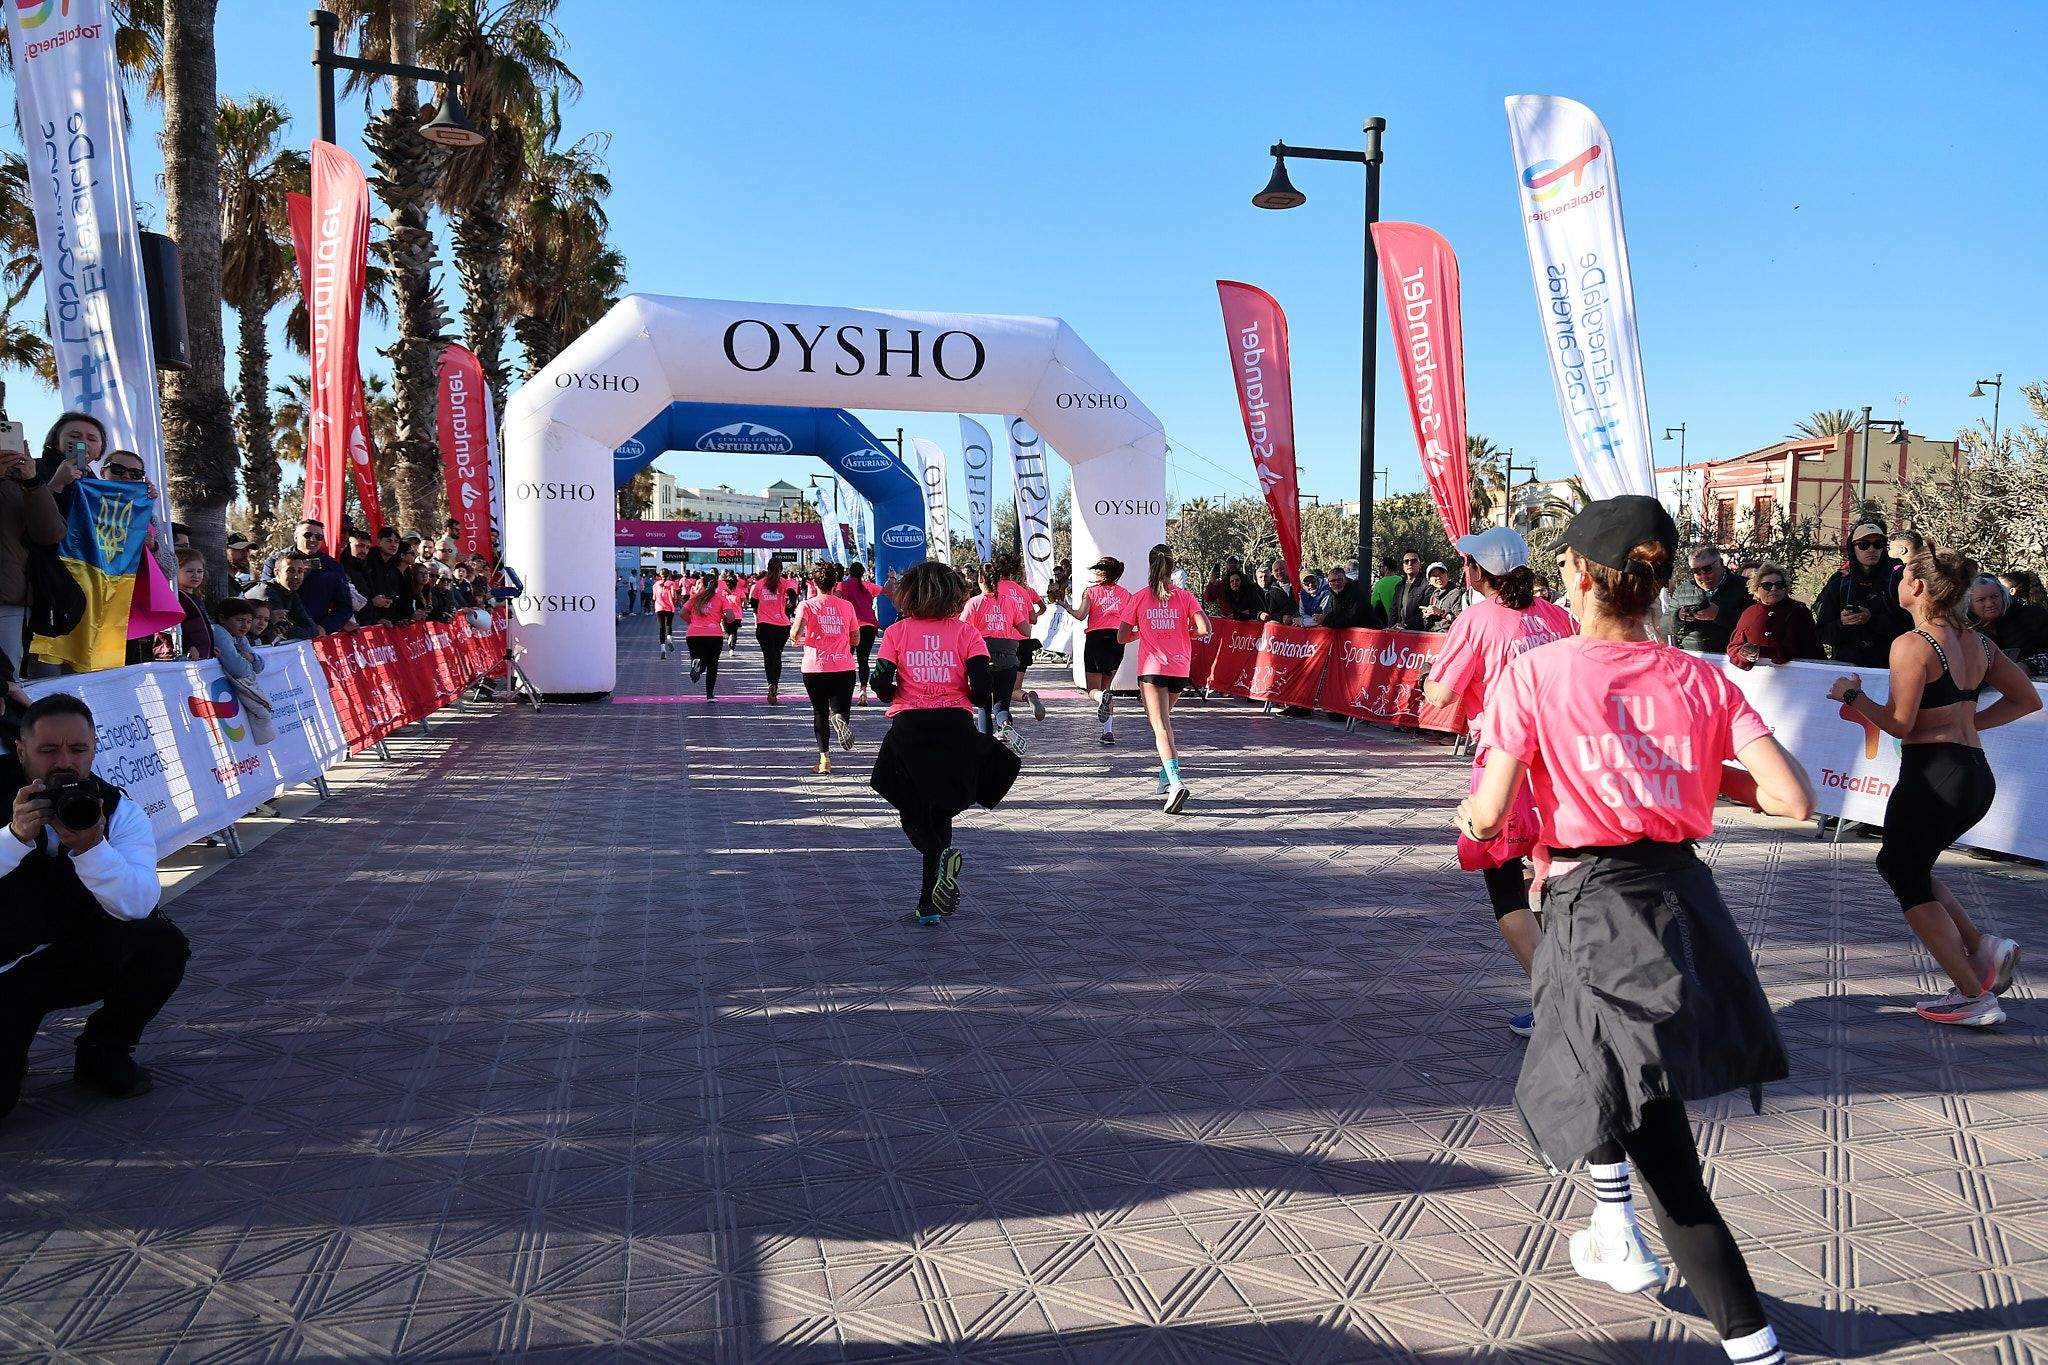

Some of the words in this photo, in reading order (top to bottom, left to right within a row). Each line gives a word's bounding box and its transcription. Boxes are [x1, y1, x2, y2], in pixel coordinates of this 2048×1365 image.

[723, 319, 986, 381] OYSHO
[555, 373, 640, 393] OYSHO
[1056, 393, 1128, 409] OYSHO
[516, 482, 595, 501] OYSHO
[1094, 500, 1161, 515] OYSHO
[519, 595, 595, 612] OYSHO
[825, 606, 836, 616] TU
[1146, 608, 1180, 619] DORSAL
[820, 624, 841, 635] SUMA
[1151, 619, 1175, 630] SUMA
[923, 634, 940, 651] TU
[1228, 630, 1257, 652] Sports
[906, 650, 957, 667] DORSAL
[1340, 640, 1378, 667] Sports
[1396, 647, 1441, 669] Santa
[912, 667, 952, 683] SUMA
[1610, 695, 1655, 730] TU
[1576, 732, 1697, 773] DORSAL
[1600, 767, 1682, 810] SUMA
[1822, 768, 1891, 797] TotalEn
